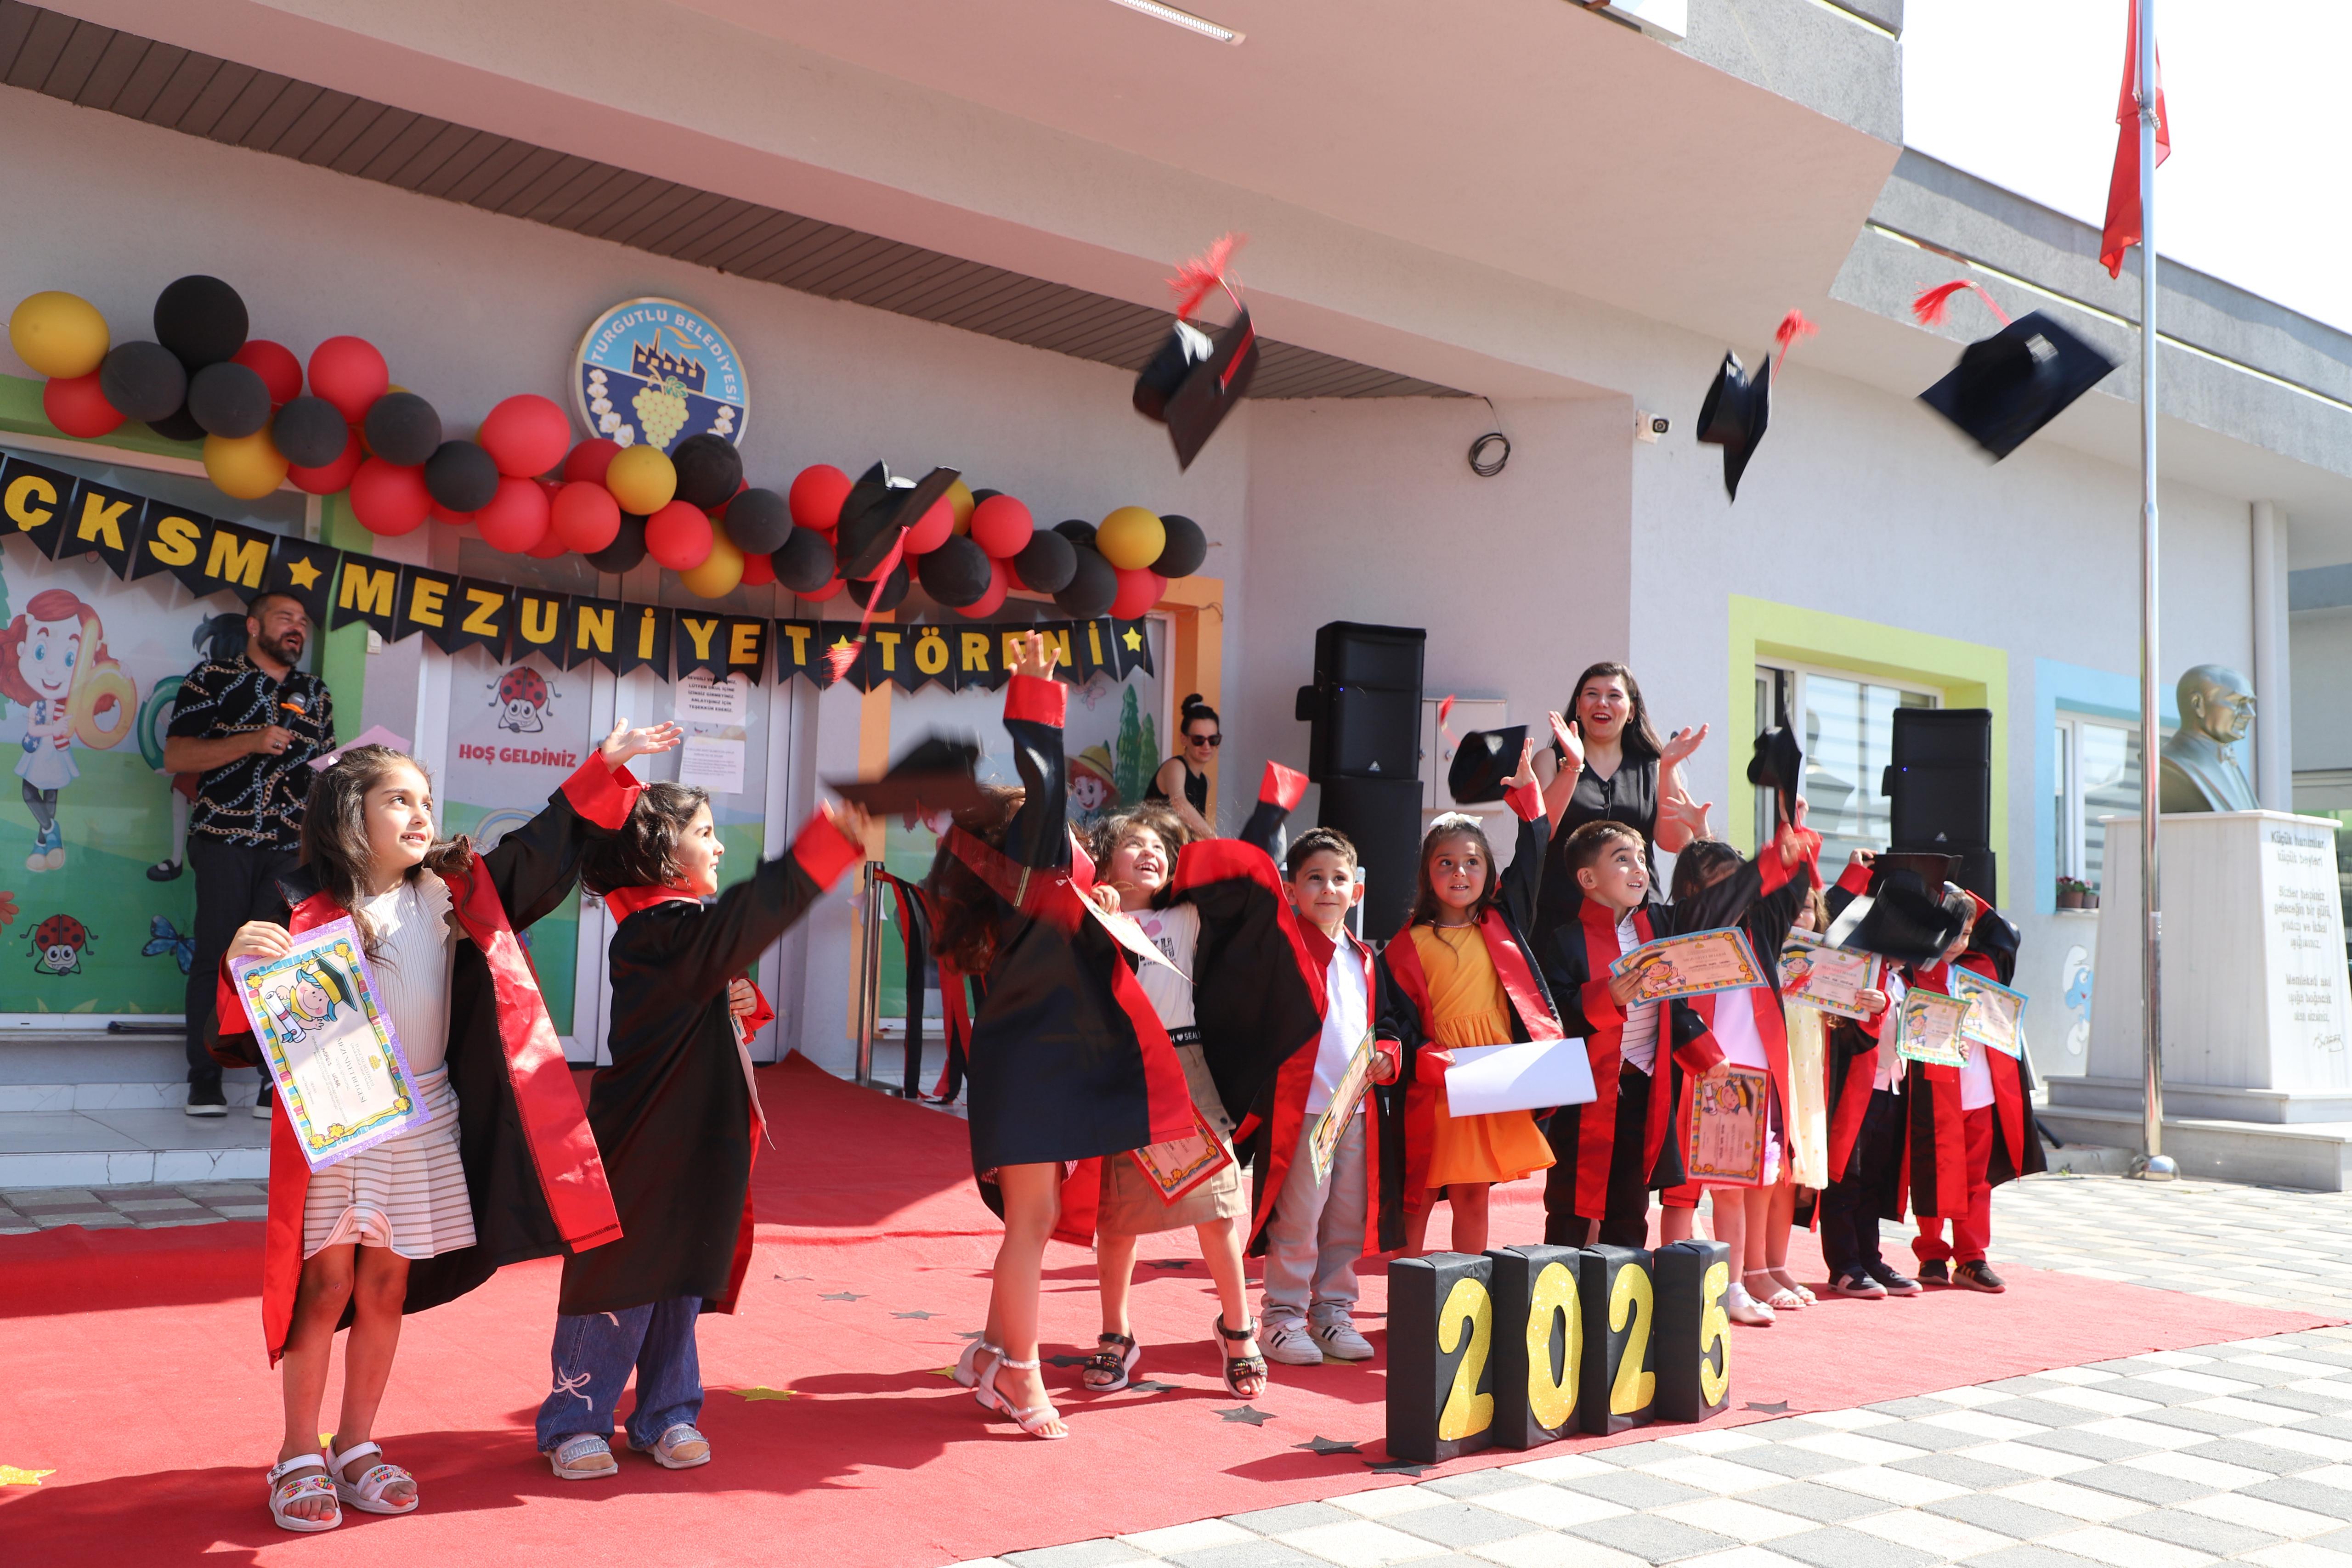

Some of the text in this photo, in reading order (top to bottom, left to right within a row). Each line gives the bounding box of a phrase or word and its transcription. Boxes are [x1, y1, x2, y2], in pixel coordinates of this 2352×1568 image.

[591, 309, 740, 401] TURGUTLU BELEDİYESİ
[4, 475, 270, 589] ÇKSM
[339, 563, 810, 666] MEZUNİYET
[459, 744, 576, 767] HOŞ GELDİNİZ
[2271, 830, 2326, 851] Küçük hanımlar,
[2275, 902, 2304, 916] geleceğin
[2301, 888, 2325, 902] hepiniz
[336, 1037, 367, 1102] MEZUNİYET BELGESİ
[1438, 1261, 1731, 1441] 2025
